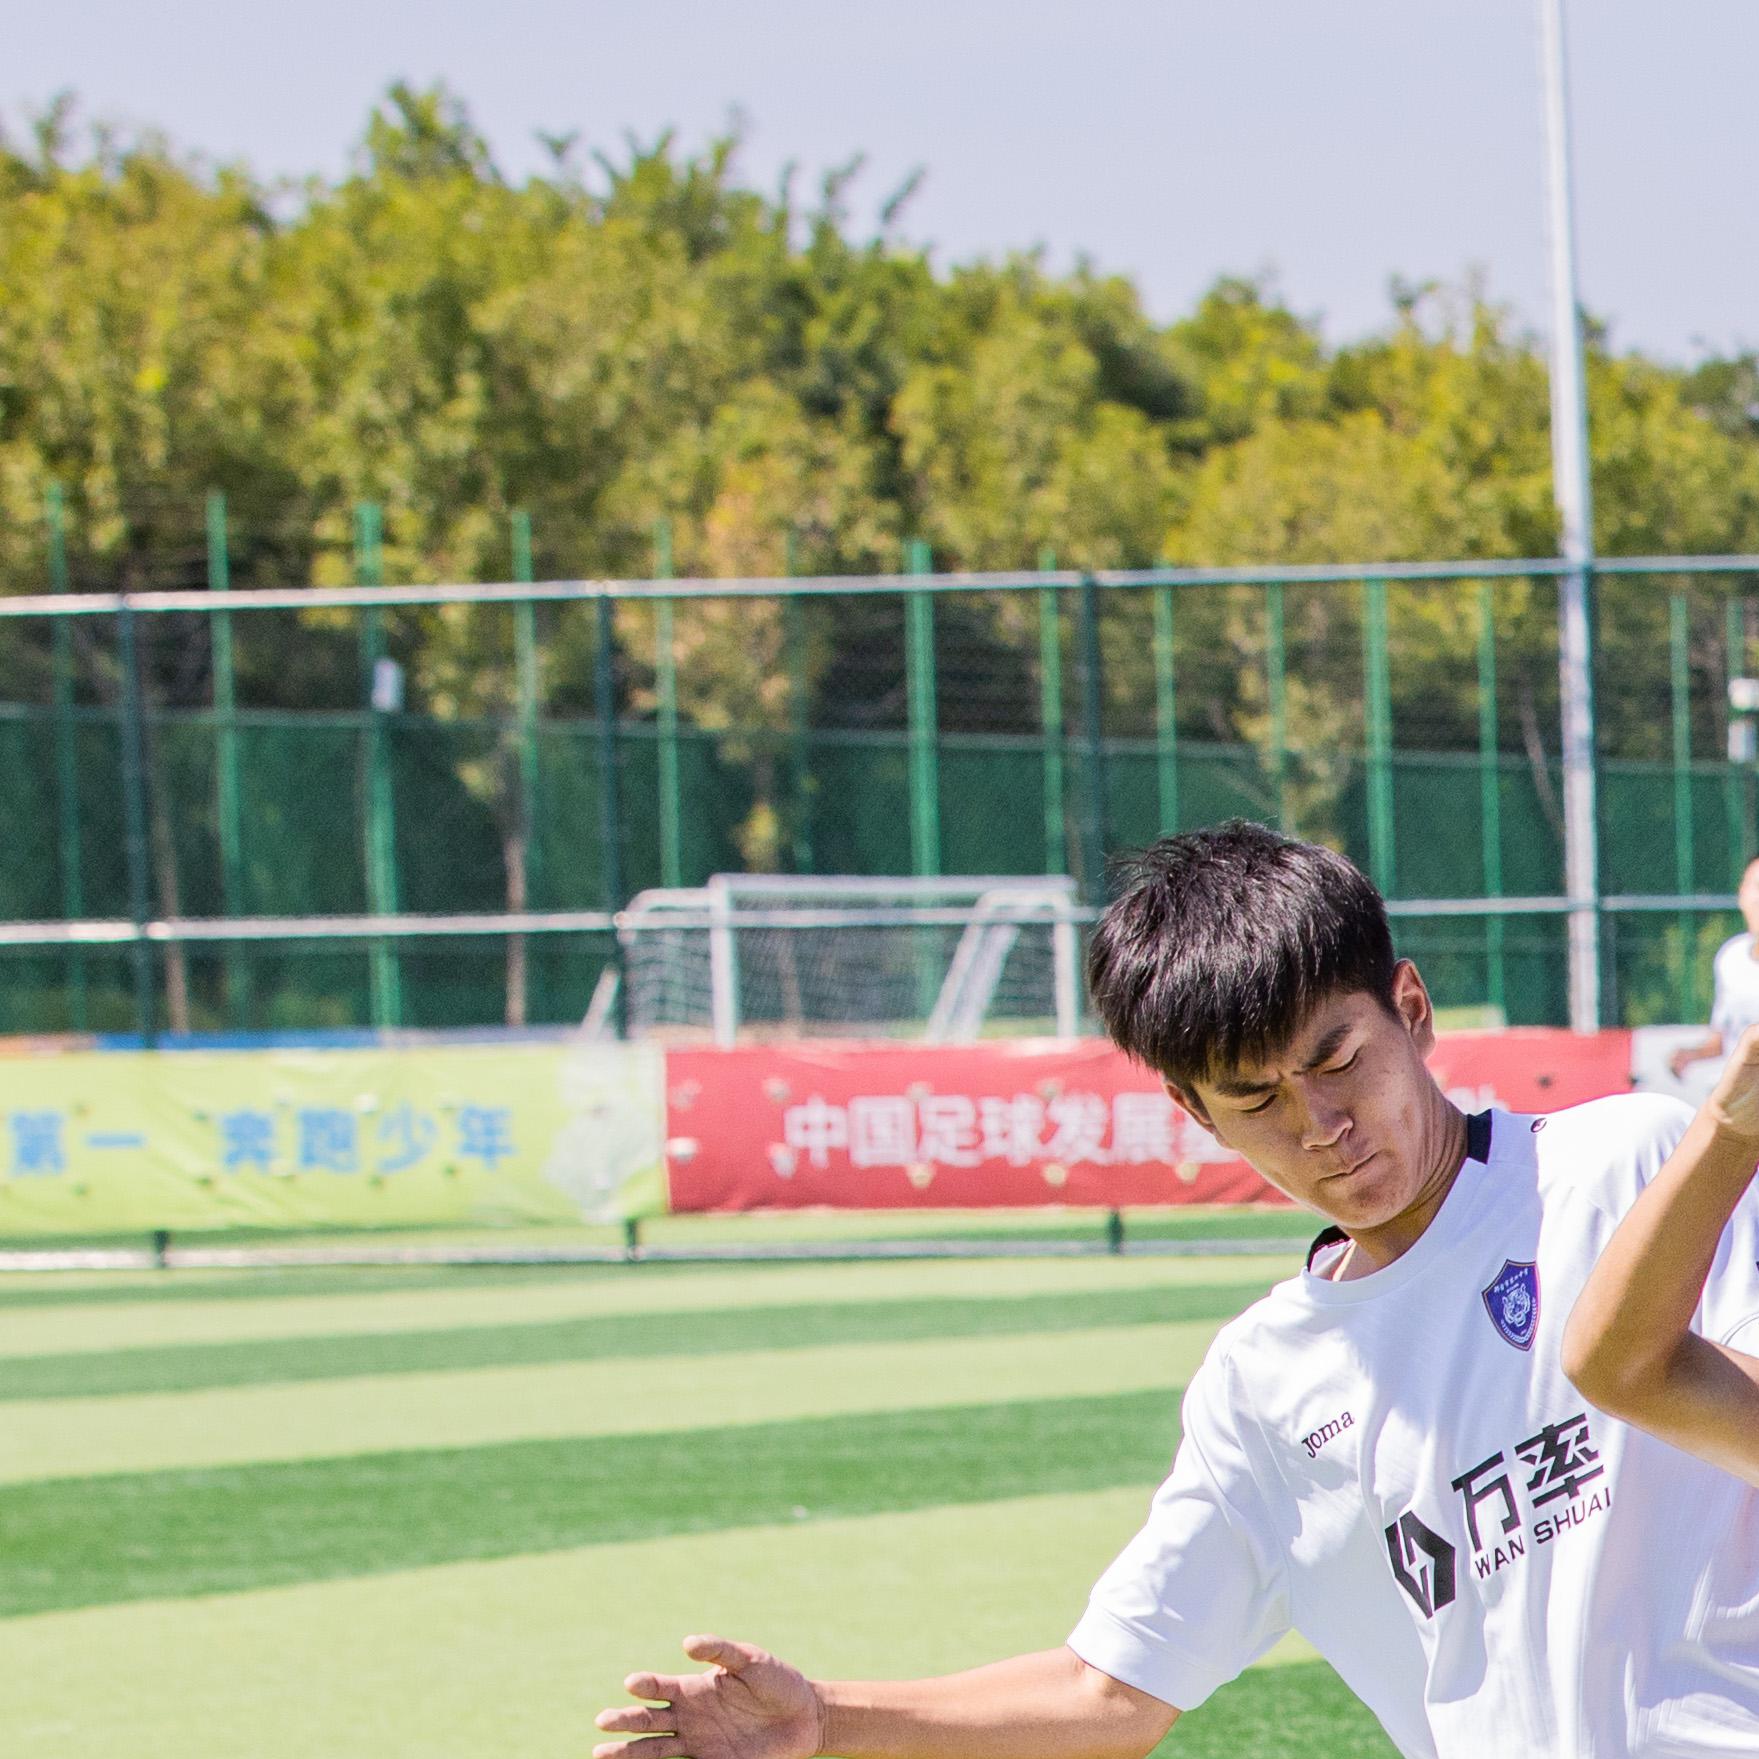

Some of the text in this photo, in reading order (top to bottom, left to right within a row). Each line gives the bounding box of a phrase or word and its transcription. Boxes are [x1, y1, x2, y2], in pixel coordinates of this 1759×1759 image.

[9, 1102, 519, 1176] 第一 奔跑少年
[1301, 1411, 1355, 1458] Joma
[1451, 1412, 1604, 1553] 万率
[1475, 1487, 1611, 1579] WAN SHUAI
